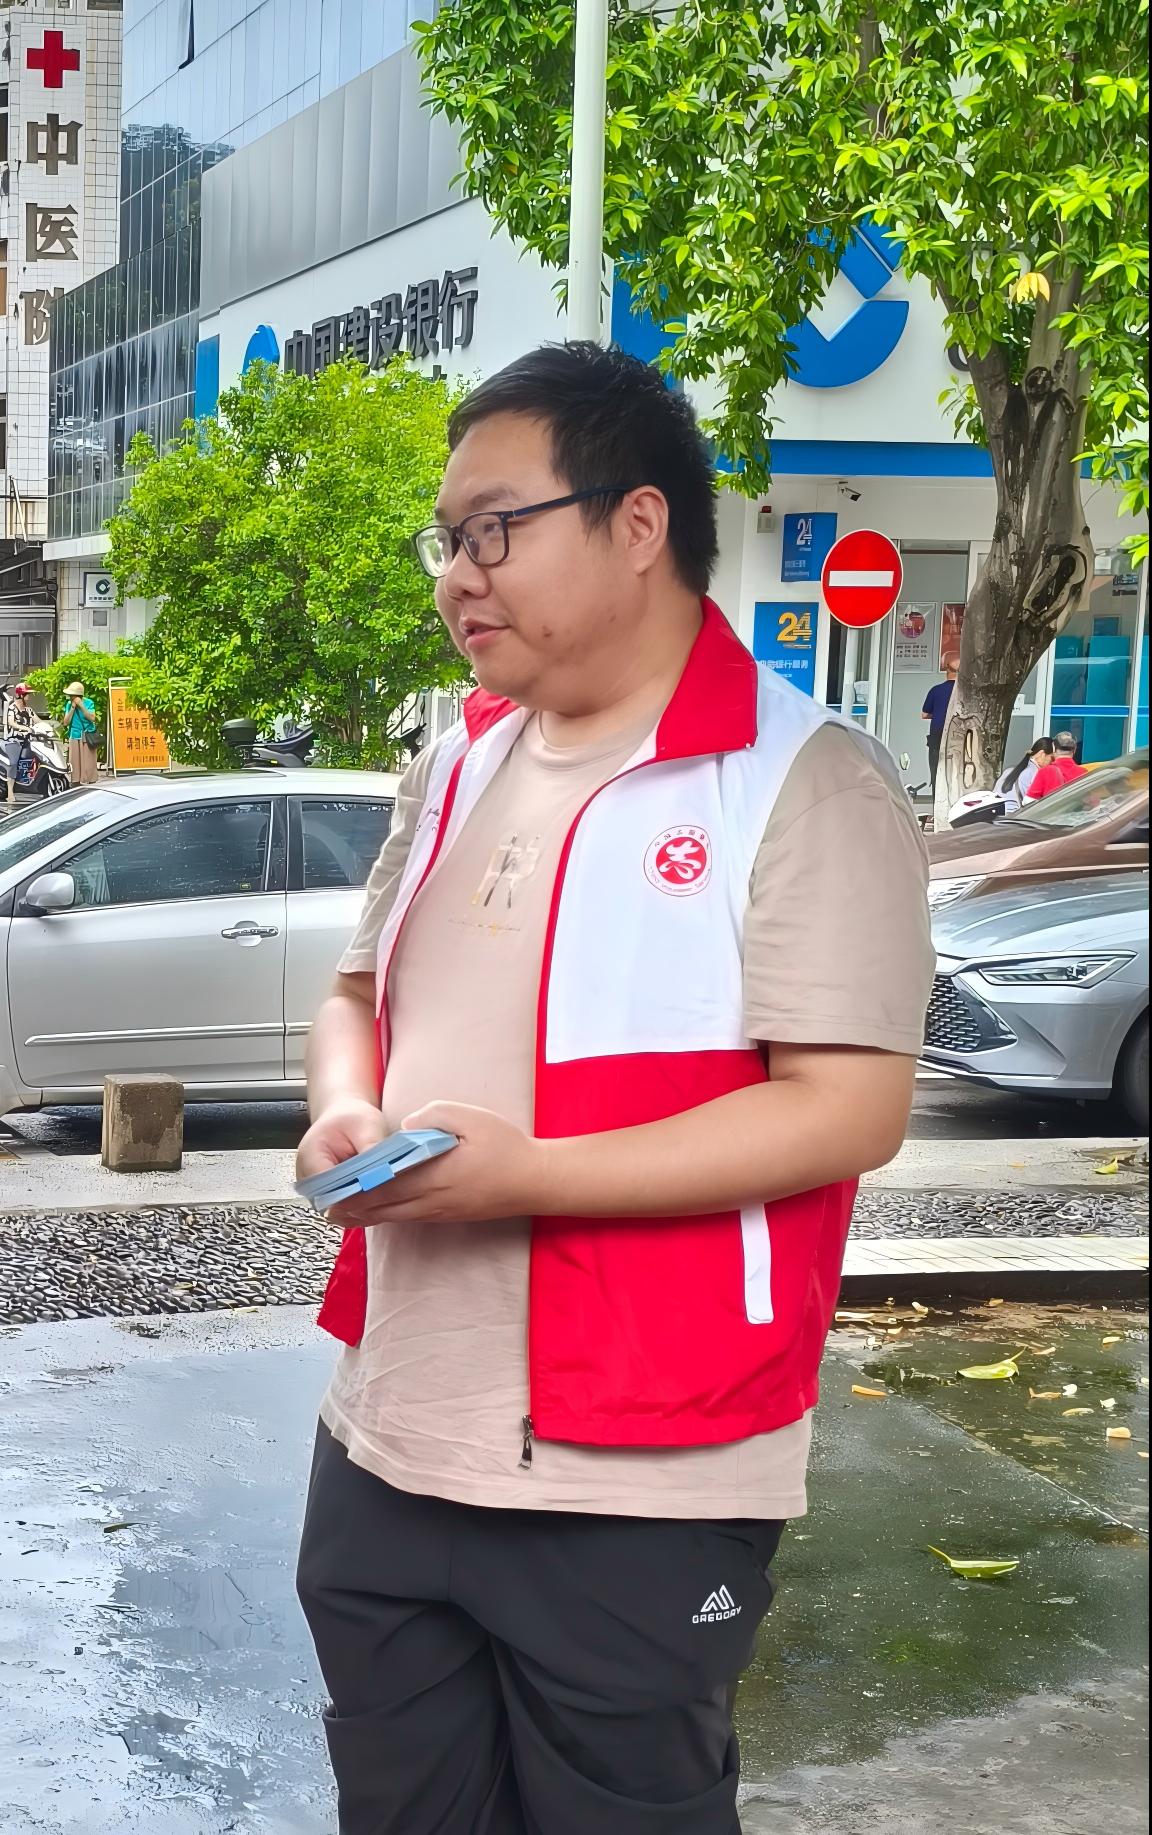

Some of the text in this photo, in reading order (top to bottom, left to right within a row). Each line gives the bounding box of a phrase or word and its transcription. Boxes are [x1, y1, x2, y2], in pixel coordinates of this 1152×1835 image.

[284, 266, 478, 381] 中国建设银行
[777, 612, 812, 641] 24
[692, 1606, 742, 1624] GREGORY
